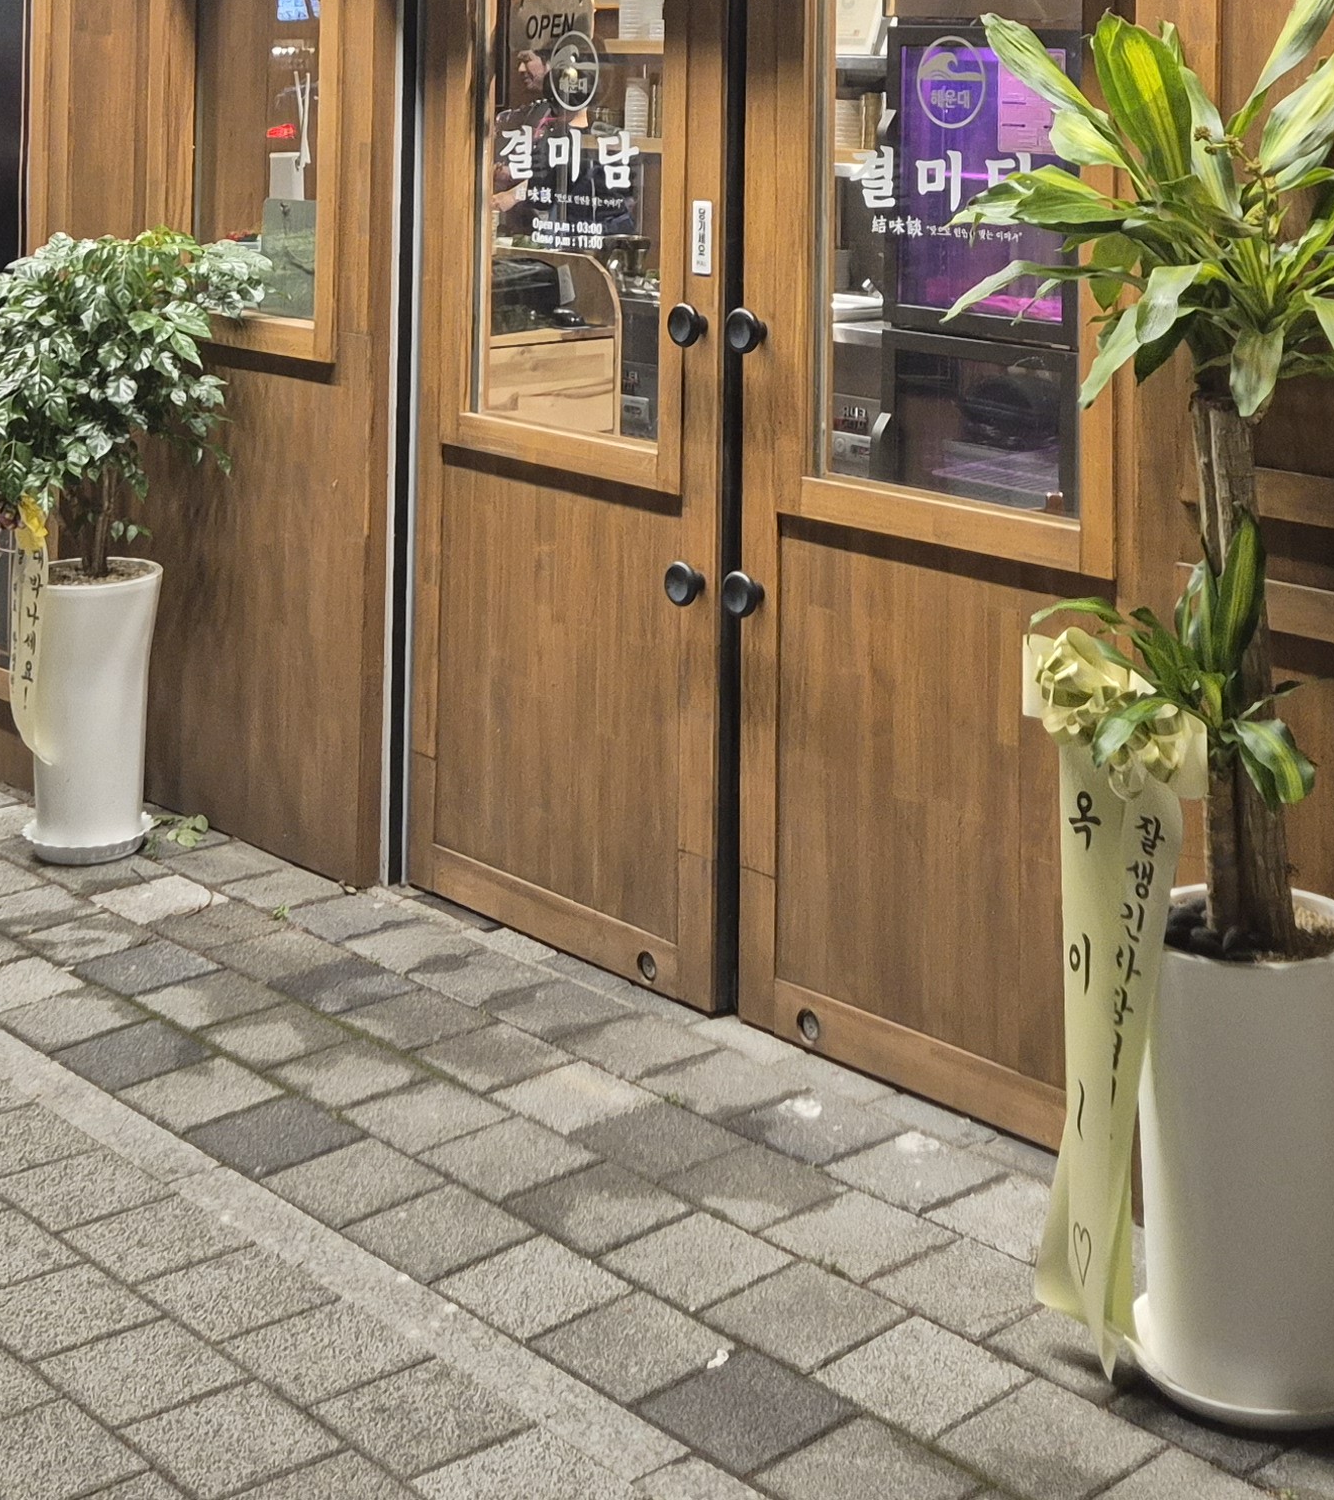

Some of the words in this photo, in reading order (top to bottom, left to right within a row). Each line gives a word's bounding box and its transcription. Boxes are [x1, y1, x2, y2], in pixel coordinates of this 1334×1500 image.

[527, 12, 575, 40] OPEN
[931, 89, 971, 109] 해운대
[500, 125, 640, 189] 결미담
[532, 218, 553, 231] Open
[577, 221, 603, 235] 03:00
[698, 208, 706, 256] 당기세요
[531, 231, 553, 245] Close
[577, 236, 603, 249] 11:00
